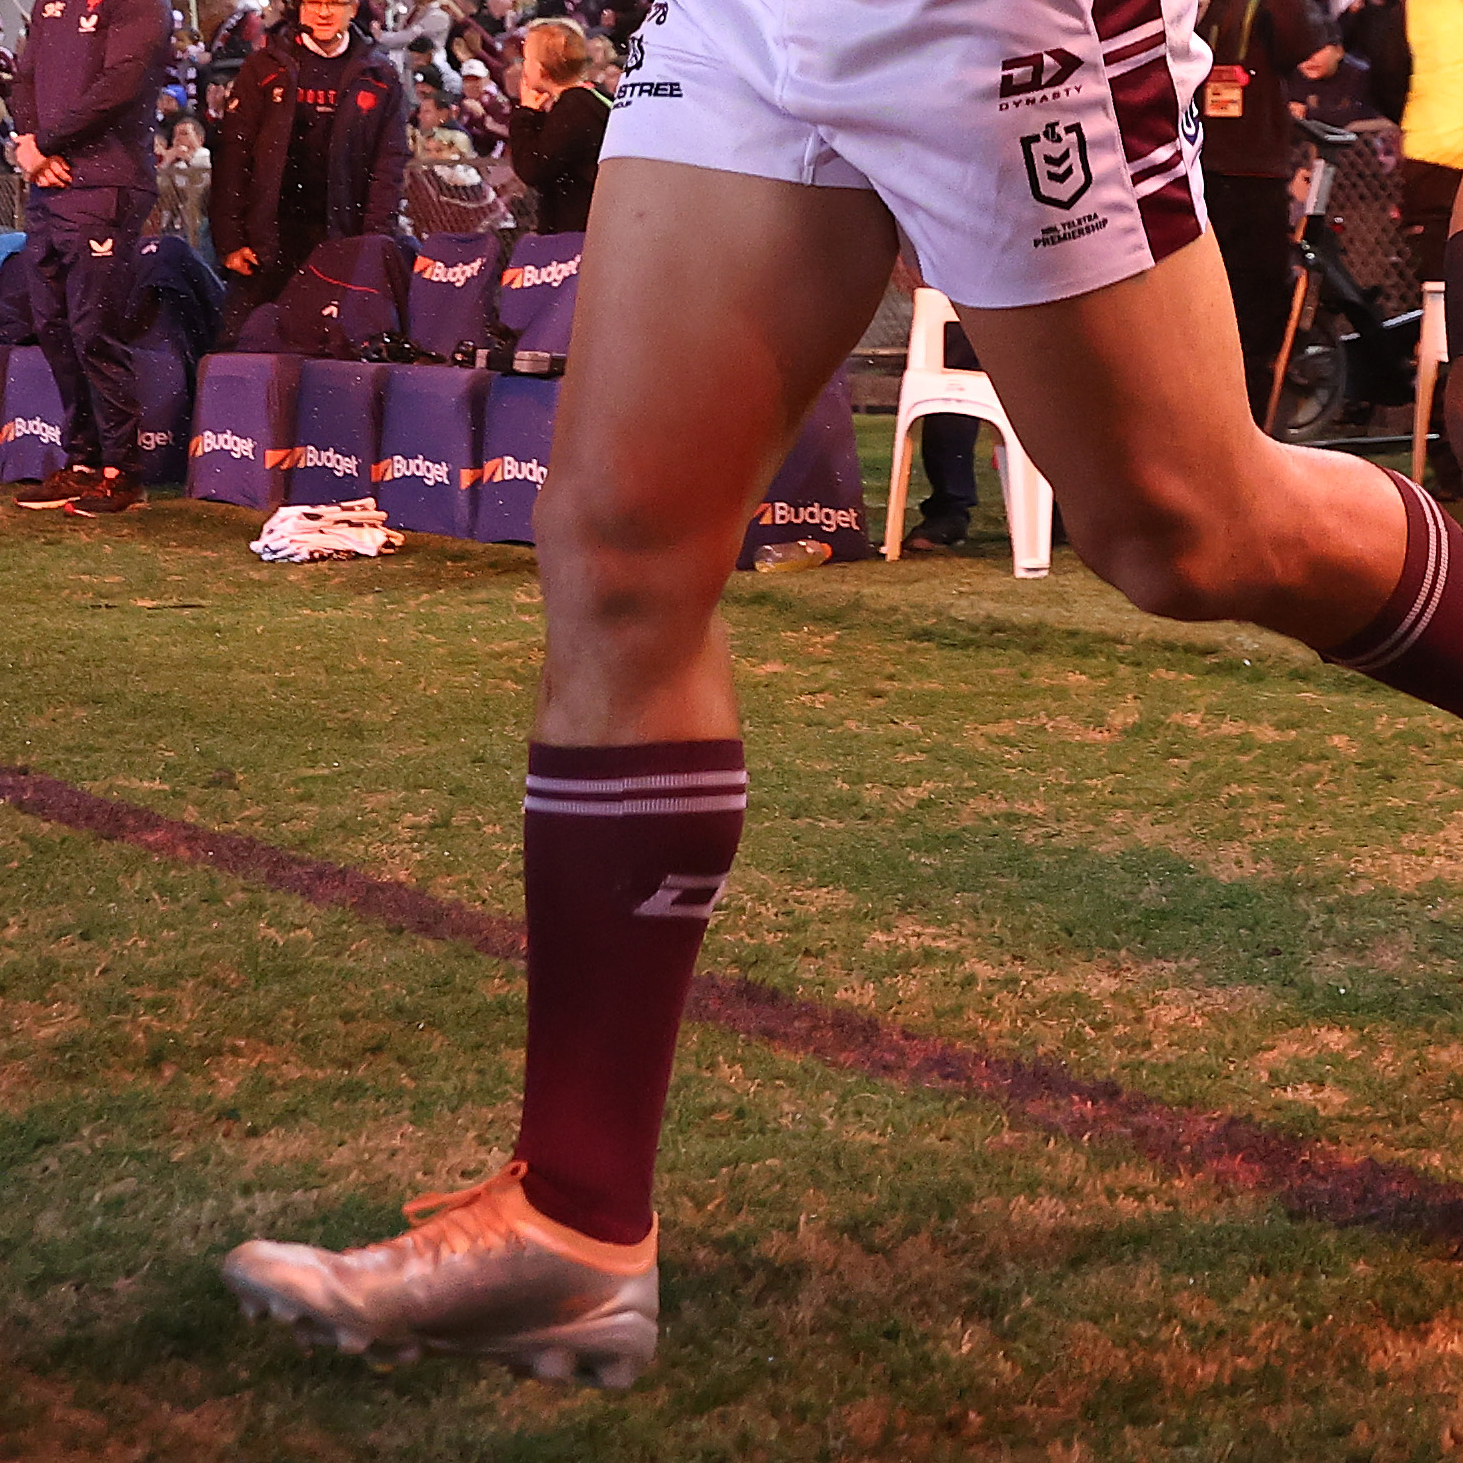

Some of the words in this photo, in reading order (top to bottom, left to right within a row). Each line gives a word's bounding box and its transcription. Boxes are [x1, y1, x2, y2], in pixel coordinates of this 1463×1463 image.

[998, 84, 1084, 112] DYNASTY
[1032, 216, 1109, 249] PREMIERSHIP
[429, 257, 485, 288] Budget
[15, 416, 62, 447] Budget
[203, 429, 256, 460] Budget
[306, 445, 360, 478] Budget
[392, 454, 451, 487] Budget
[773, 501, 861, 533] Budget
